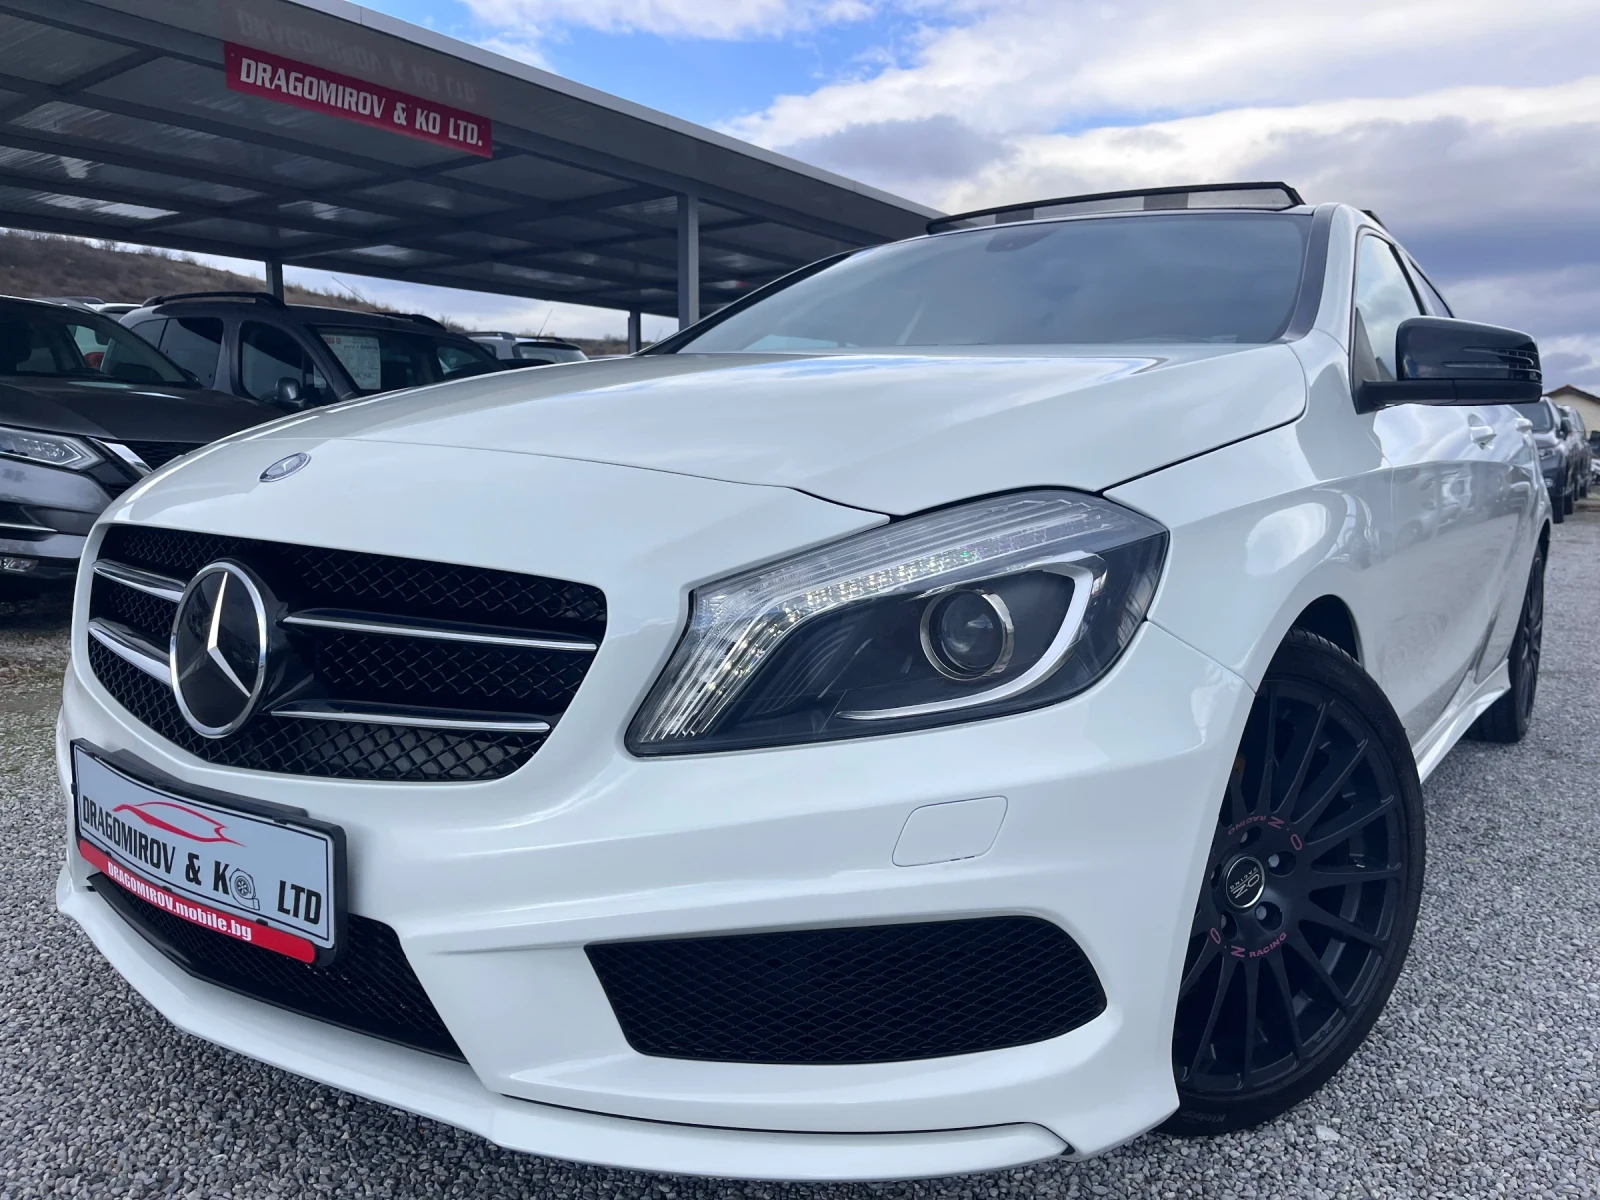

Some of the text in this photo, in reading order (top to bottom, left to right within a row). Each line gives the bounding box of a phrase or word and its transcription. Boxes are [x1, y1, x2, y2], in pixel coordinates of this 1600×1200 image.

[240, 57, 483, 147] DRAGOMIROV & KO LTD.
[82, 795, 176, 874] DRAGOMIROV
[185, 852, 202, 886] &
[277, 880, 322, 925] LTD
[1228, 815, 1267, 835] RACING
[107, 861, 252, 941] DRAGOMIROV.mobile.bg
[1249, 932, 1287, 958] RACING
